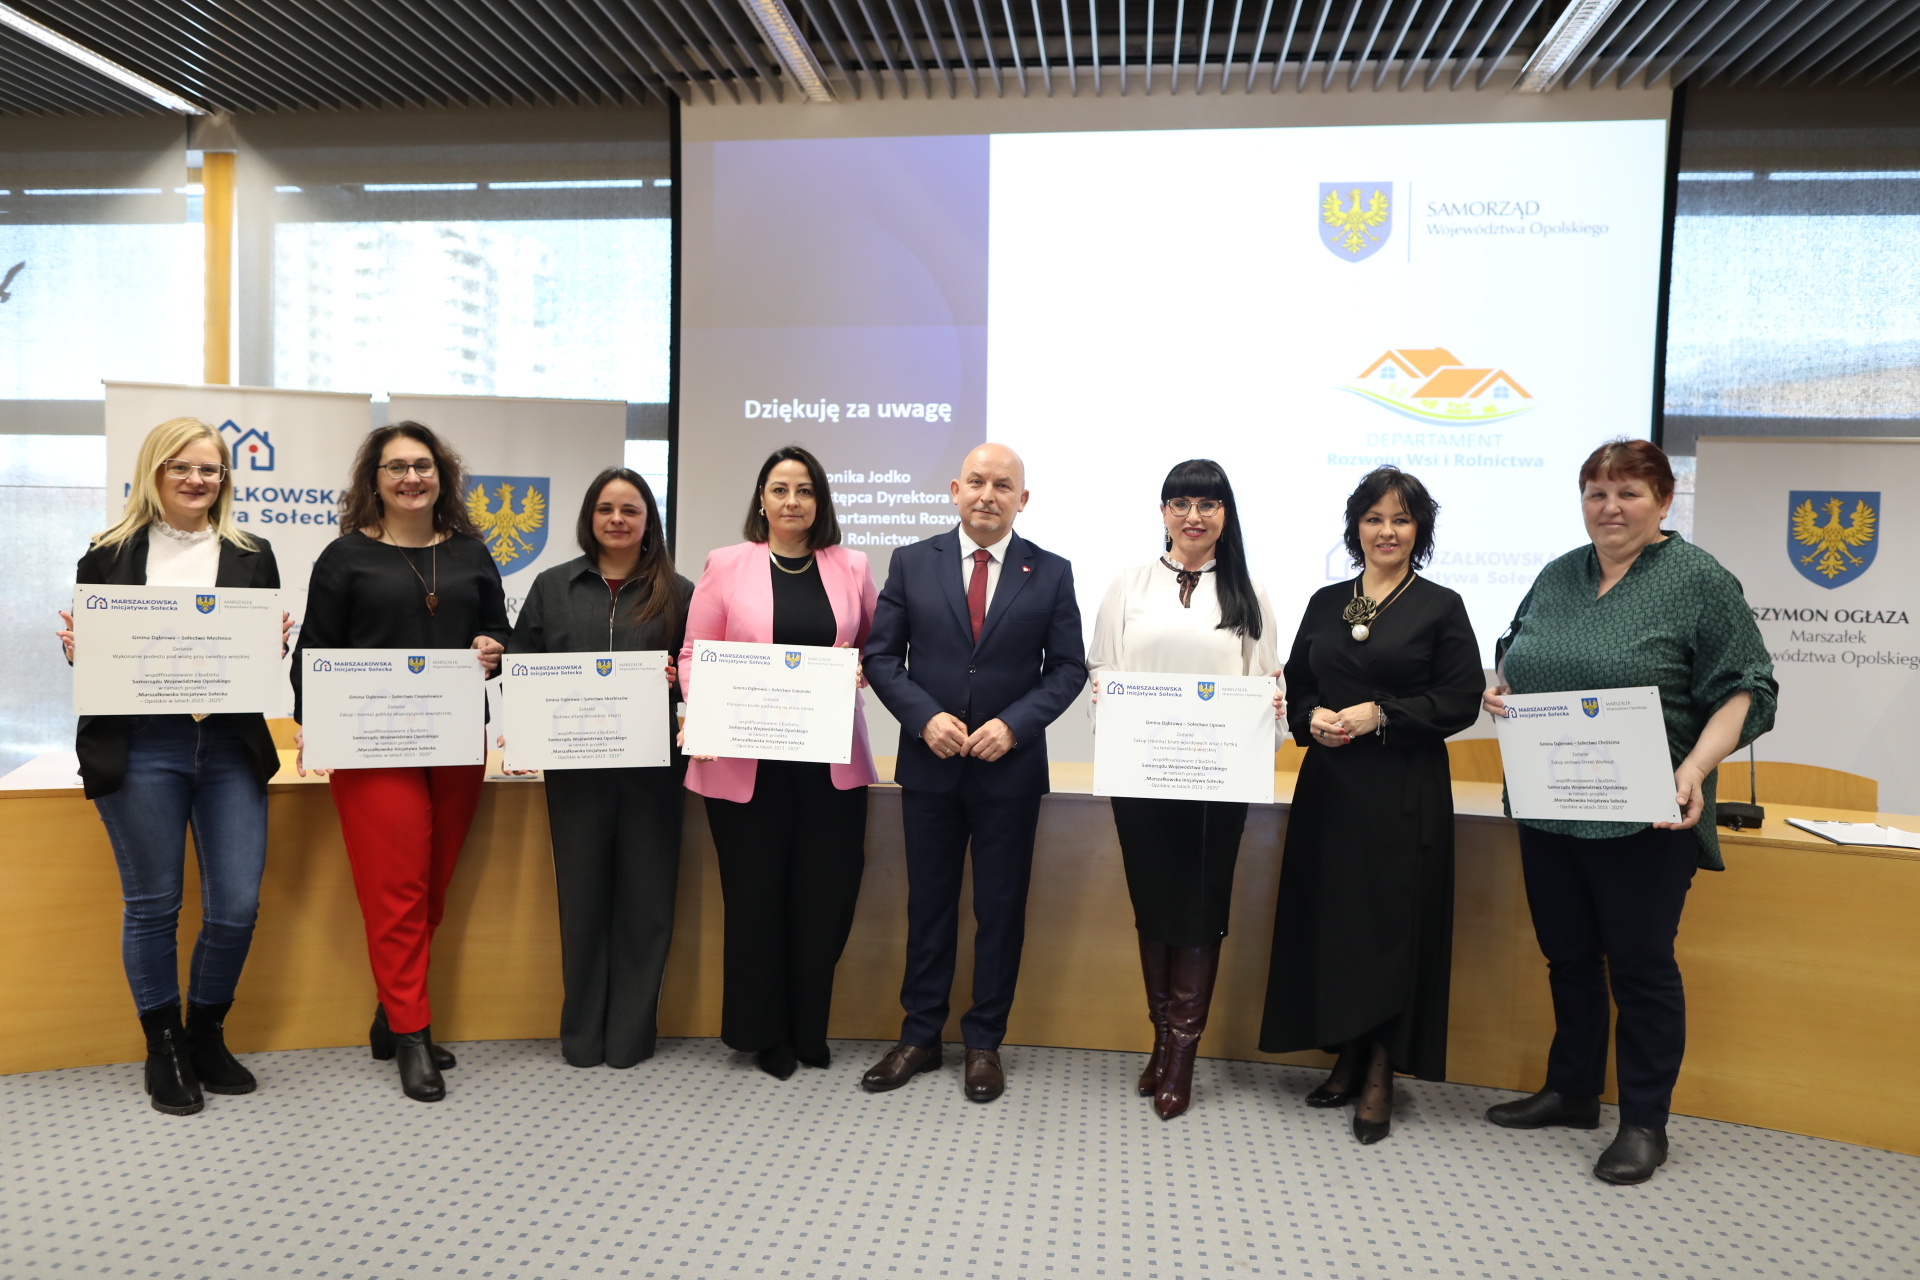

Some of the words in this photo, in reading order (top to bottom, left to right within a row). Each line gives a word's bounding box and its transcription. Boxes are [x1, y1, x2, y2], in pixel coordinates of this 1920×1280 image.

[1427, 200, 1540, 220] SAMORZĄD
[1426, 222, 1525, 238] Województwa
[1530, 221, 1609, 238] Opolskiego
[744, 398, 840, 423] Dziękuję
[846, 403, 870, 418] za
[877, 402, 952, 423] uwagę
[1366, 432, 1504, 448] DEPARTAMENT
[1327, 453, 1401, 467] Rozwoju
[1406, 454, 1438, 467] Wsi
[1444, 454, 1449, 467] i
[1454, 454, 1544, 468] Rolnictwa
[826, 469, 864, 484] onika
[868, 469, 912, 484] Jodko
[831, 491, 873, 507] tępca
[876, 490, 950, 507] Dyrektora
[260, 509, 338, 526] Sołeck
[836, 512, 916, 525] artamentu
[919, 512, 962, 525] Rozw
[848, 532, 920, 546] Rolnictwa
[1430, 552, 1558, 566] SZAŁKOWSKA
[1487, 571, 1536, 585] Sołec
[1752, 607, 1828, 622] SZYMON
[1834, 608, 1910, 624] OGŁAZA
[1790, 629, 1867, 644] Marszałek
[1770, 648, 1836, 664] wództwa
[1841, 650, 1920, 670] Opolskieg
[1126, 684, 1181, 692] MARSZAŁKOWSKA
